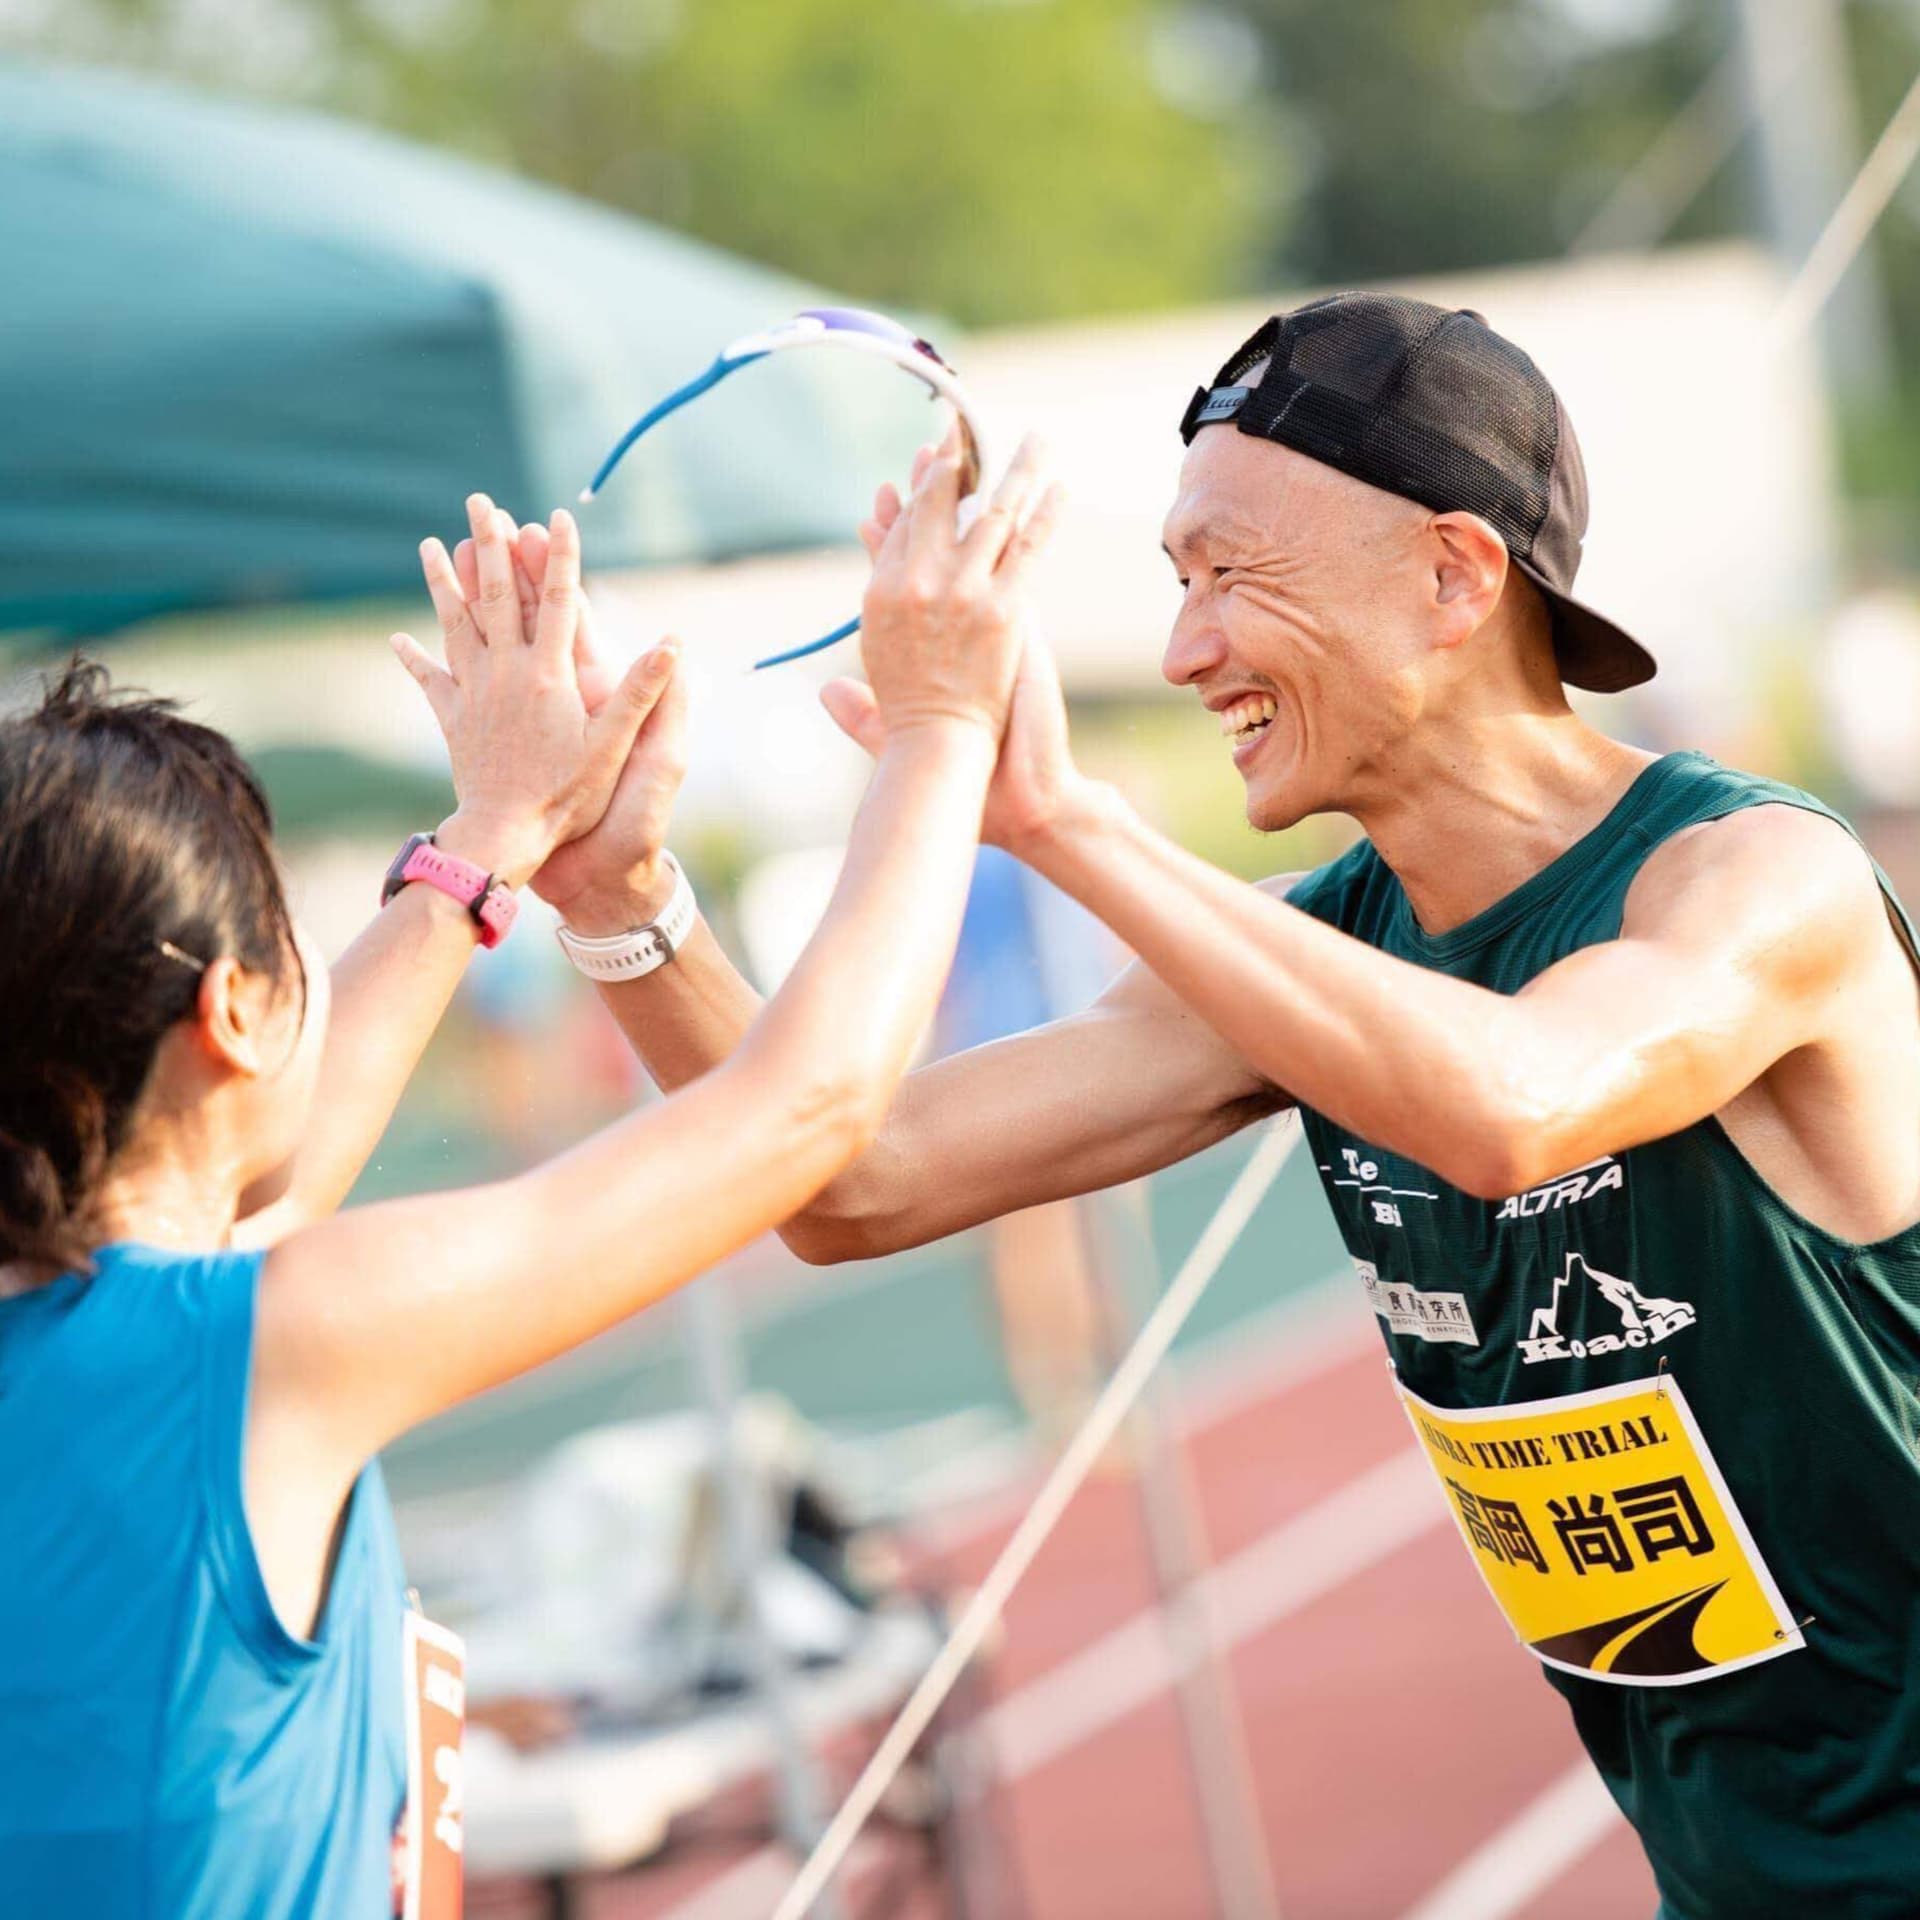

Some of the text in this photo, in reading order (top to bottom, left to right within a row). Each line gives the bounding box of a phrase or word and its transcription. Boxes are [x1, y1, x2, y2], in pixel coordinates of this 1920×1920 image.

[1495, 1164, 1624, 1219] ALTRA
[1516, 1309, 1697, 1365] Koach
[1470, 1437, 1552, 1469] TIME
[1551, 1415, 1669, 1463] TRIAL
[1445, 1474, 1716, 1576] 高岡 尚司
